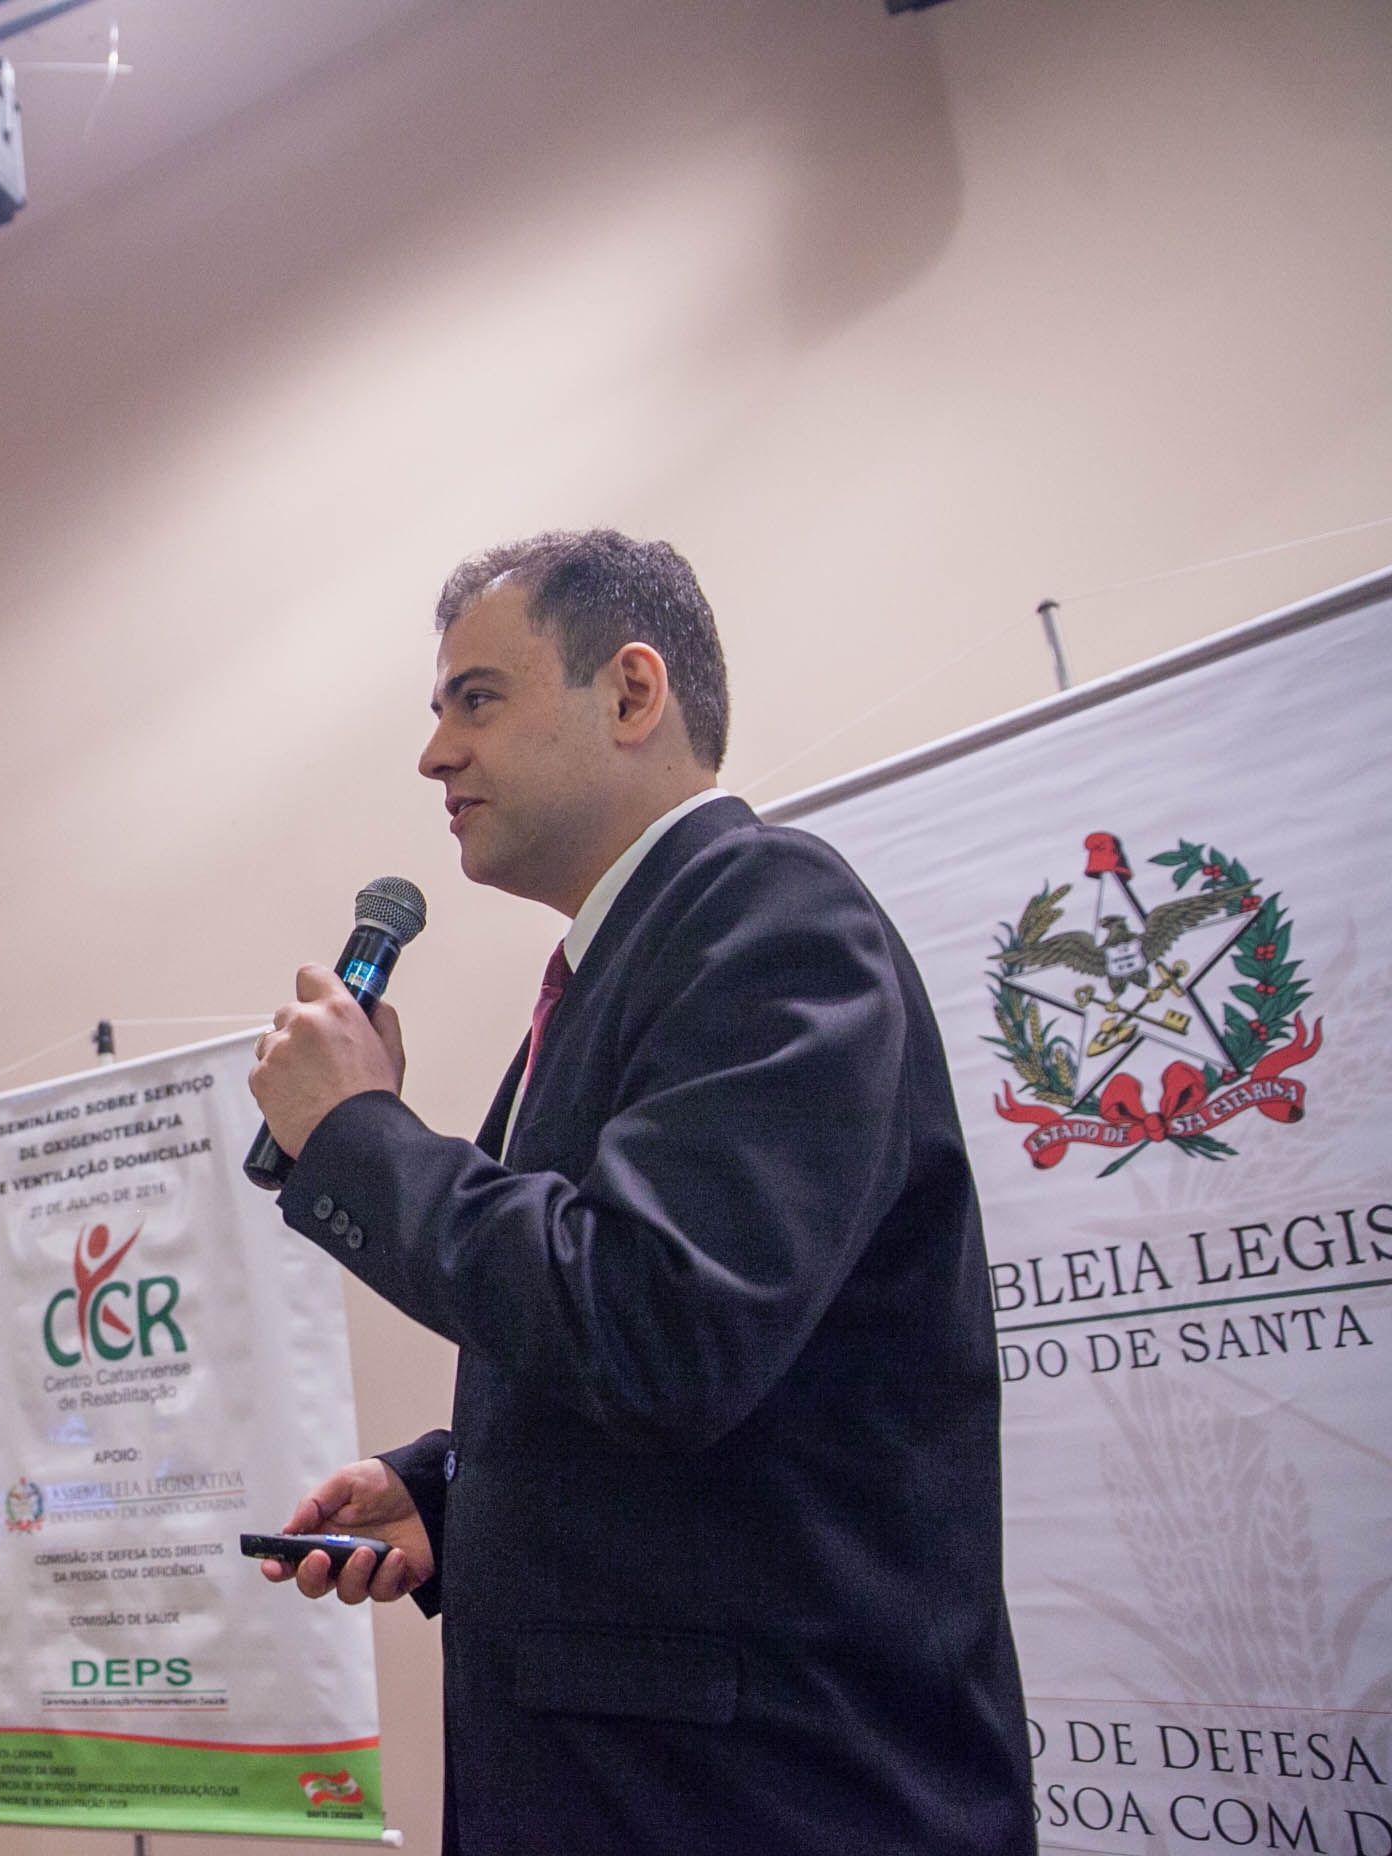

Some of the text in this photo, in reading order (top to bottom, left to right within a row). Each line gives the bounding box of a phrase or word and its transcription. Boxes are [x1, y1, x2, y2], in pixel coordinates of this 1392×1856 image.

[85, 1092, 139, 1117] SOBRE
[143, 1074, 215, 1103] SERVIÇO
[1172, 1080, 1298, 1136] STA CATARINA
[18, 1113, 184, 1162] DE OXIGENOTERAPIA
[1029, 1123, 1129, 1152] ESTADO DE
[11, 1158, 108, 1191] VENTILAÇÃO
[113, 1137, 212, 1171] DOMICILIAR
[989, 1203, 1392, 1312] BLEIA LEGIS
[43, 1275, 188, 1368] CCR
[999, 1304, 1374, 1383] DO DE SANTA
[43, 1361, 192, 1393] Centro Catarinense
[58, 1383, 177, 1411] de Reabilitação
[146, 1471, 246, 1495] LEGISLATIVA
[108, 1548, 148, 1562] DEFESA
[70, 1657, 193, 1687] DEPS
[1066, 1720, 1138, 1766] DE
[1155, 1724, 1388, 1786] DEFESA
[1169, 1794, 1328, 1855] COM
